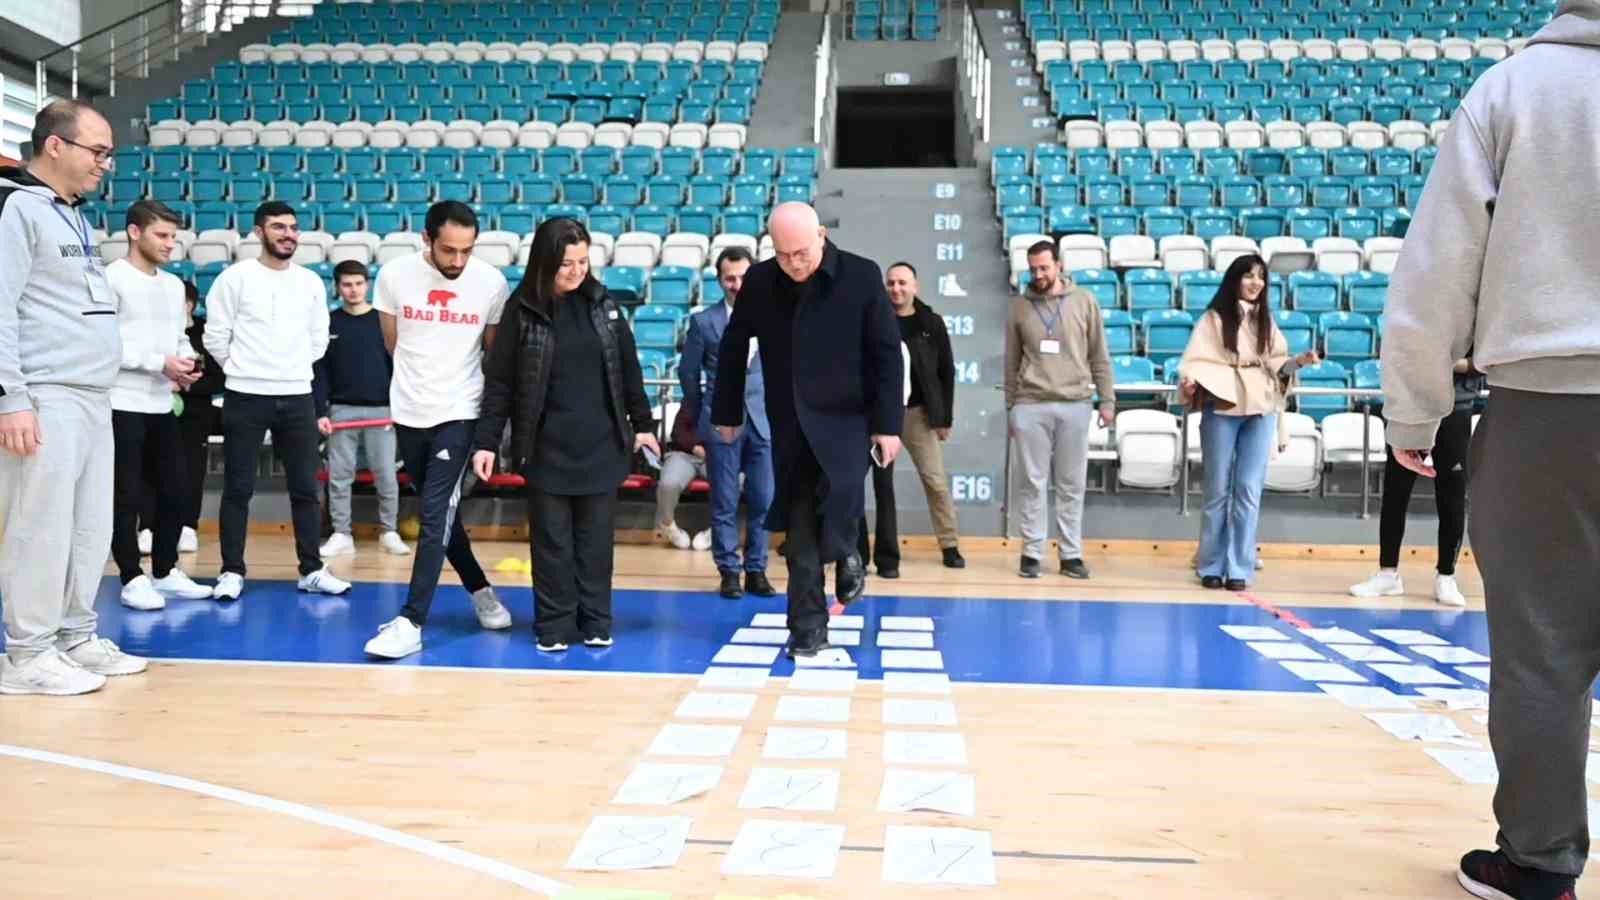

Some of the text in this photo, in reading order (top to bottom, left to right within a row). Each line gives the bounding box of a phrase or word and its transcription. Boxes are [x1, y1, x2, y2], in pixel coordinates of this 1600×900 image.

[935, 183, 955, 198] E9
[934, 213, 961, 230] E10
[936, 243, 963, 261] E11
[953, 361, 979, 383] 14
[951, 475, 991, 500] E16
